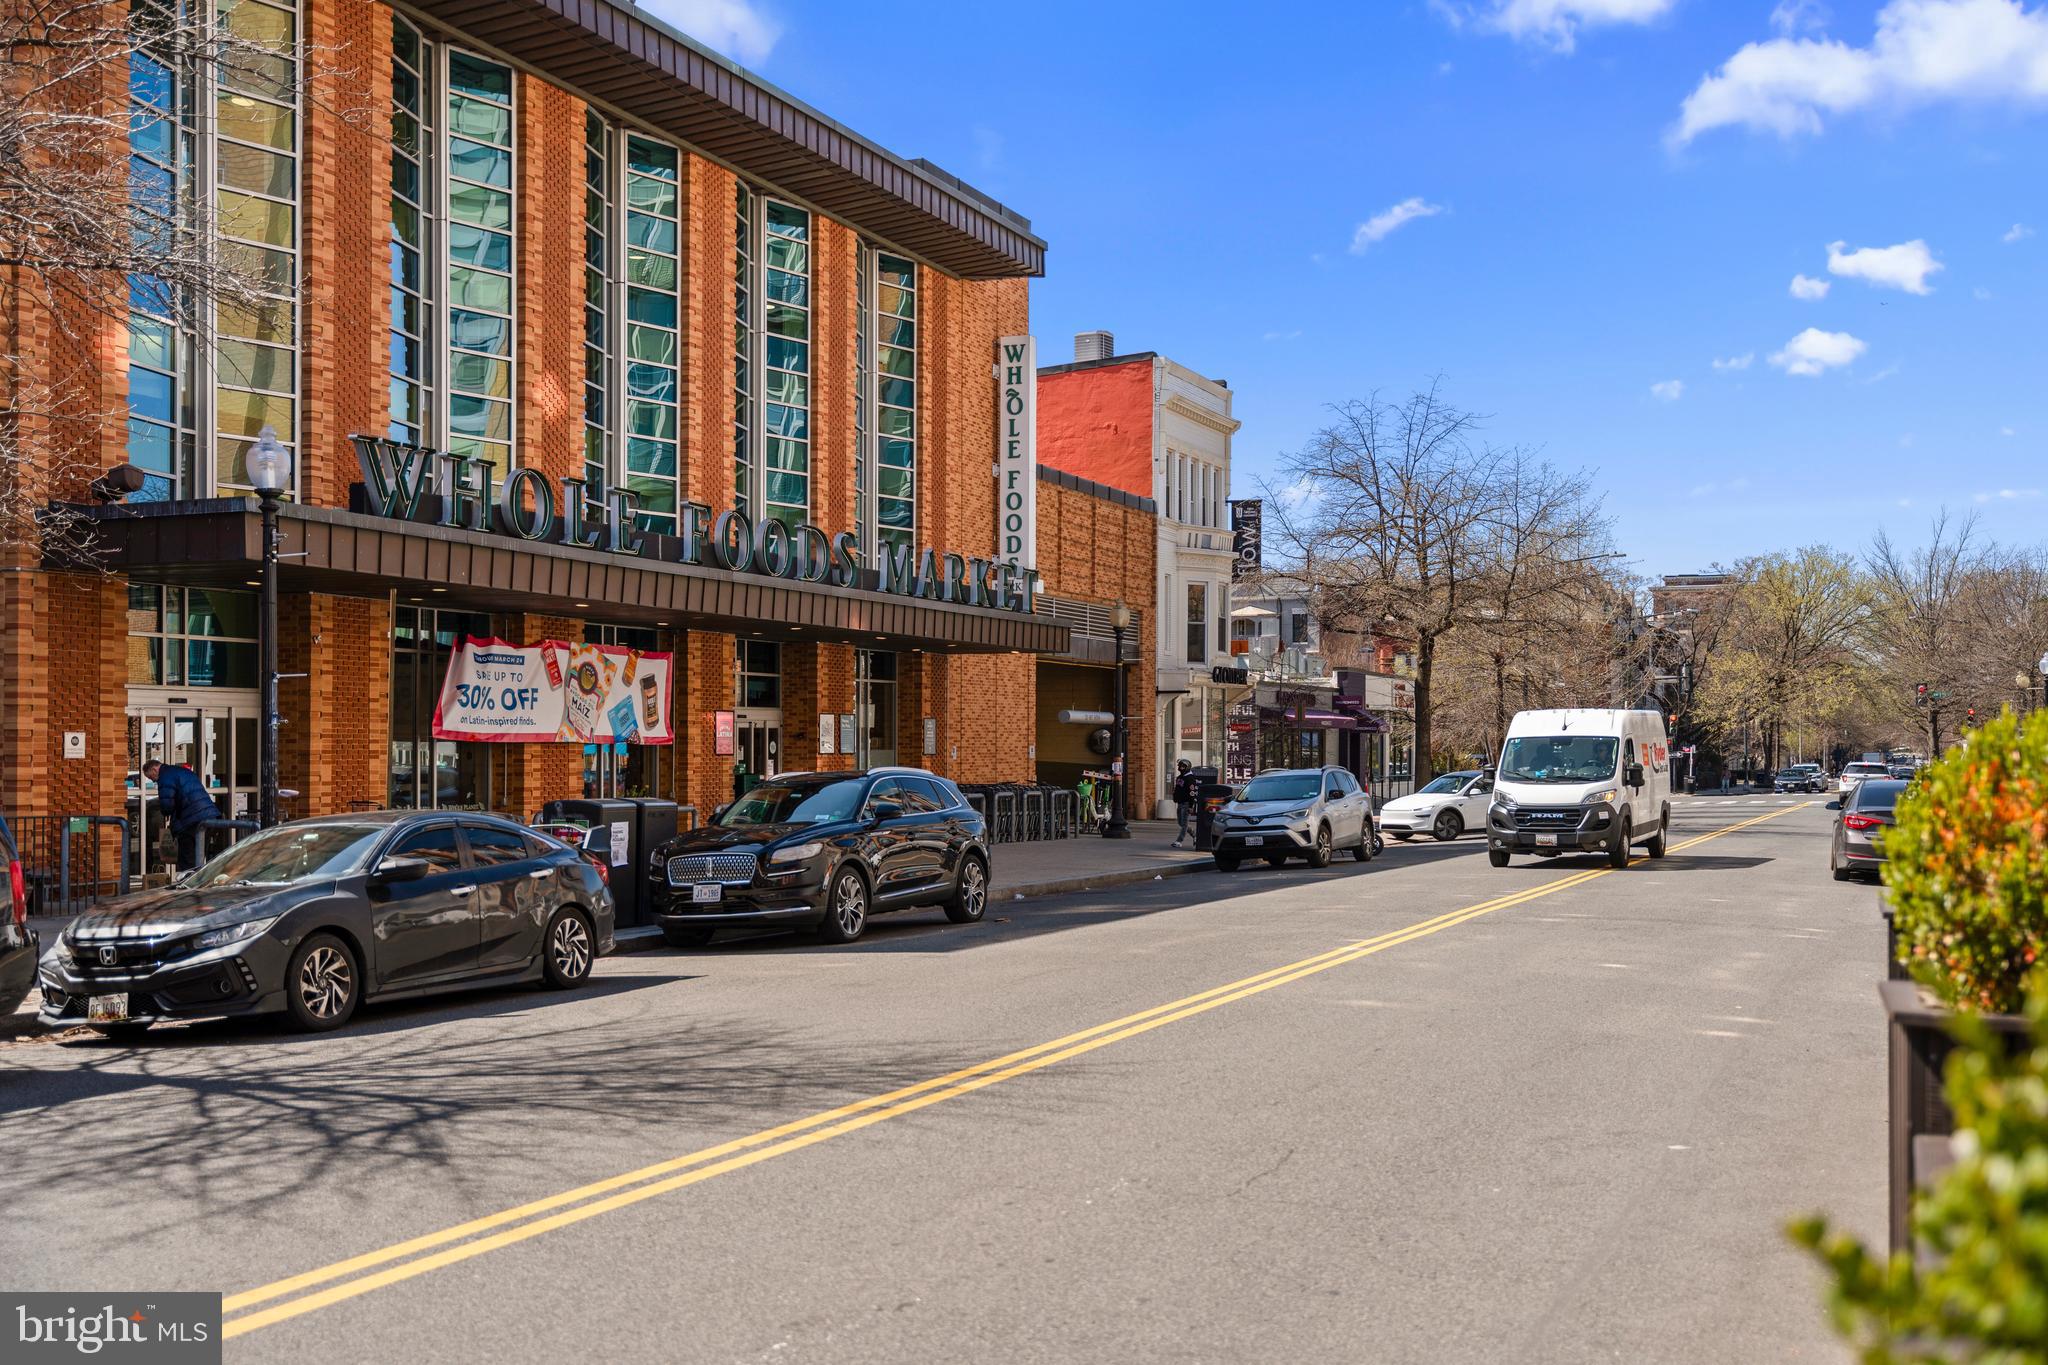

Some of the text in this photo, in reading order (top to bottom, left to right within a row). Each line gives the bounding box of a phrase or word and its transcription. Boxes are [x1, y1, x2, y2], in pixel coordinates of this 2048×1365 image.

[1003, 344, 1026, 459] WHOLE
[348, 434, 1039, 614] WHOLE FOODS MARKET
[494, 655, 515, 663] MARCH
[494, 671, 507, 681] UP
[510, 672, 523, 682] TO
[456, 683, 539, 711] 30% OFF
[469, 715, 518, 727] Latin-inspired
